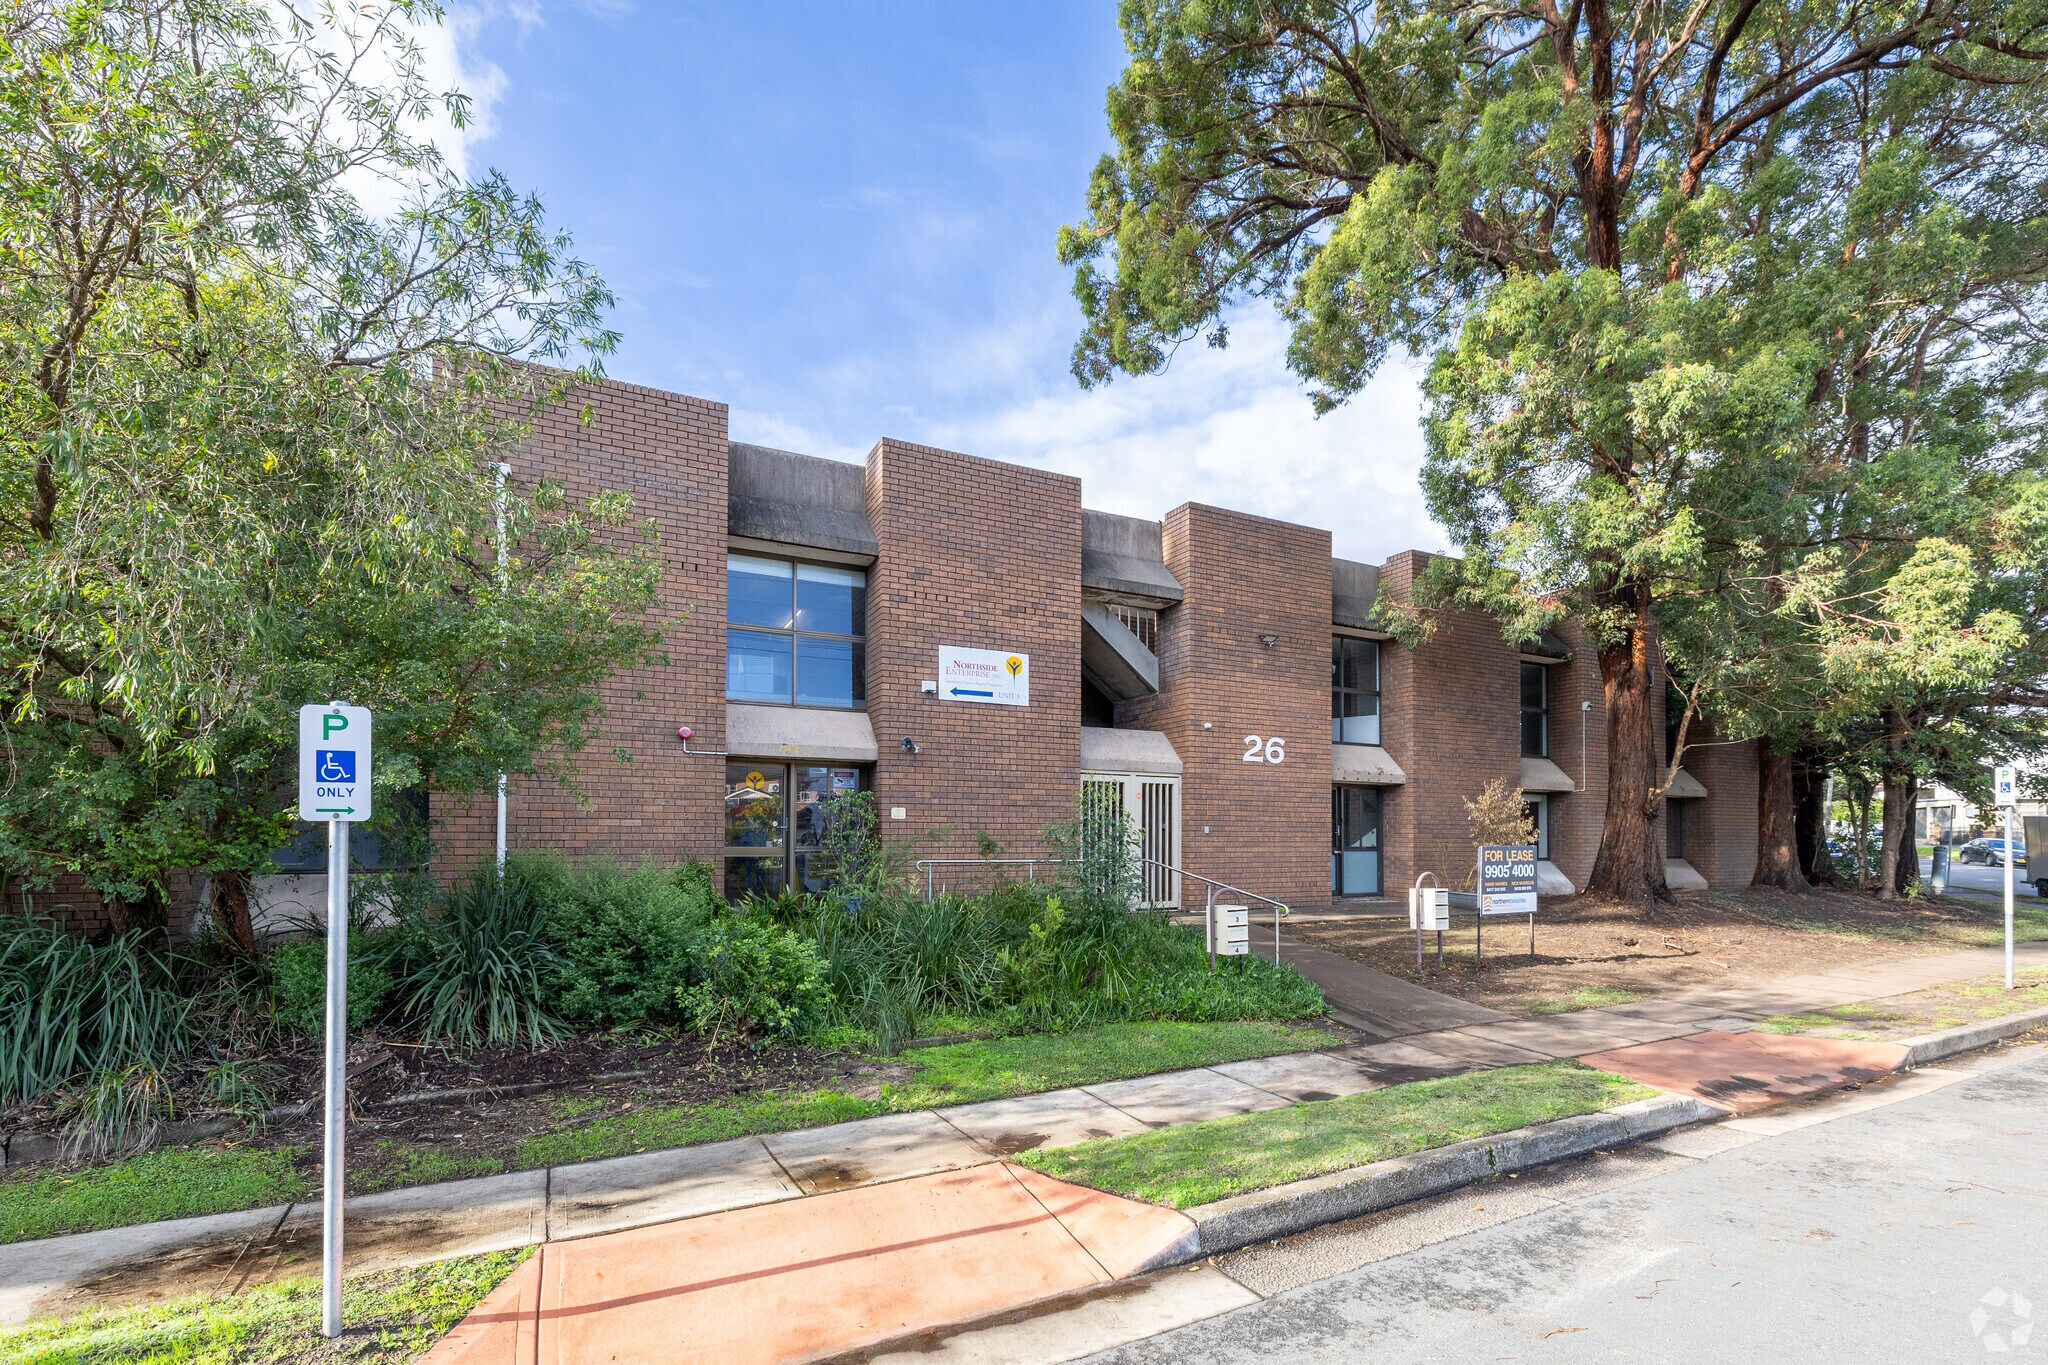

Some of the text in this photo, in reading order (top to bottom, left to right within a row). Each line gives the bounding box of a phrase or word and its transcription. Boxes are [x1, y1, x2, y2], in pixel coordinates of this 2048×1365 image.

[946, 666, 990, 678] ENTERPRISE
[953, 660, 998, 672] NORTHSIDE
[322, 714, 349, 740] P
[1243, 735, 1285, 764] 26
[2002, 770, 2010, 779] P
[316, 787, 354, 797] ONLY
[1485, 850, 1534, 861] FOR LEASE
[1485, 864, 1534, 878] 9905 4000
